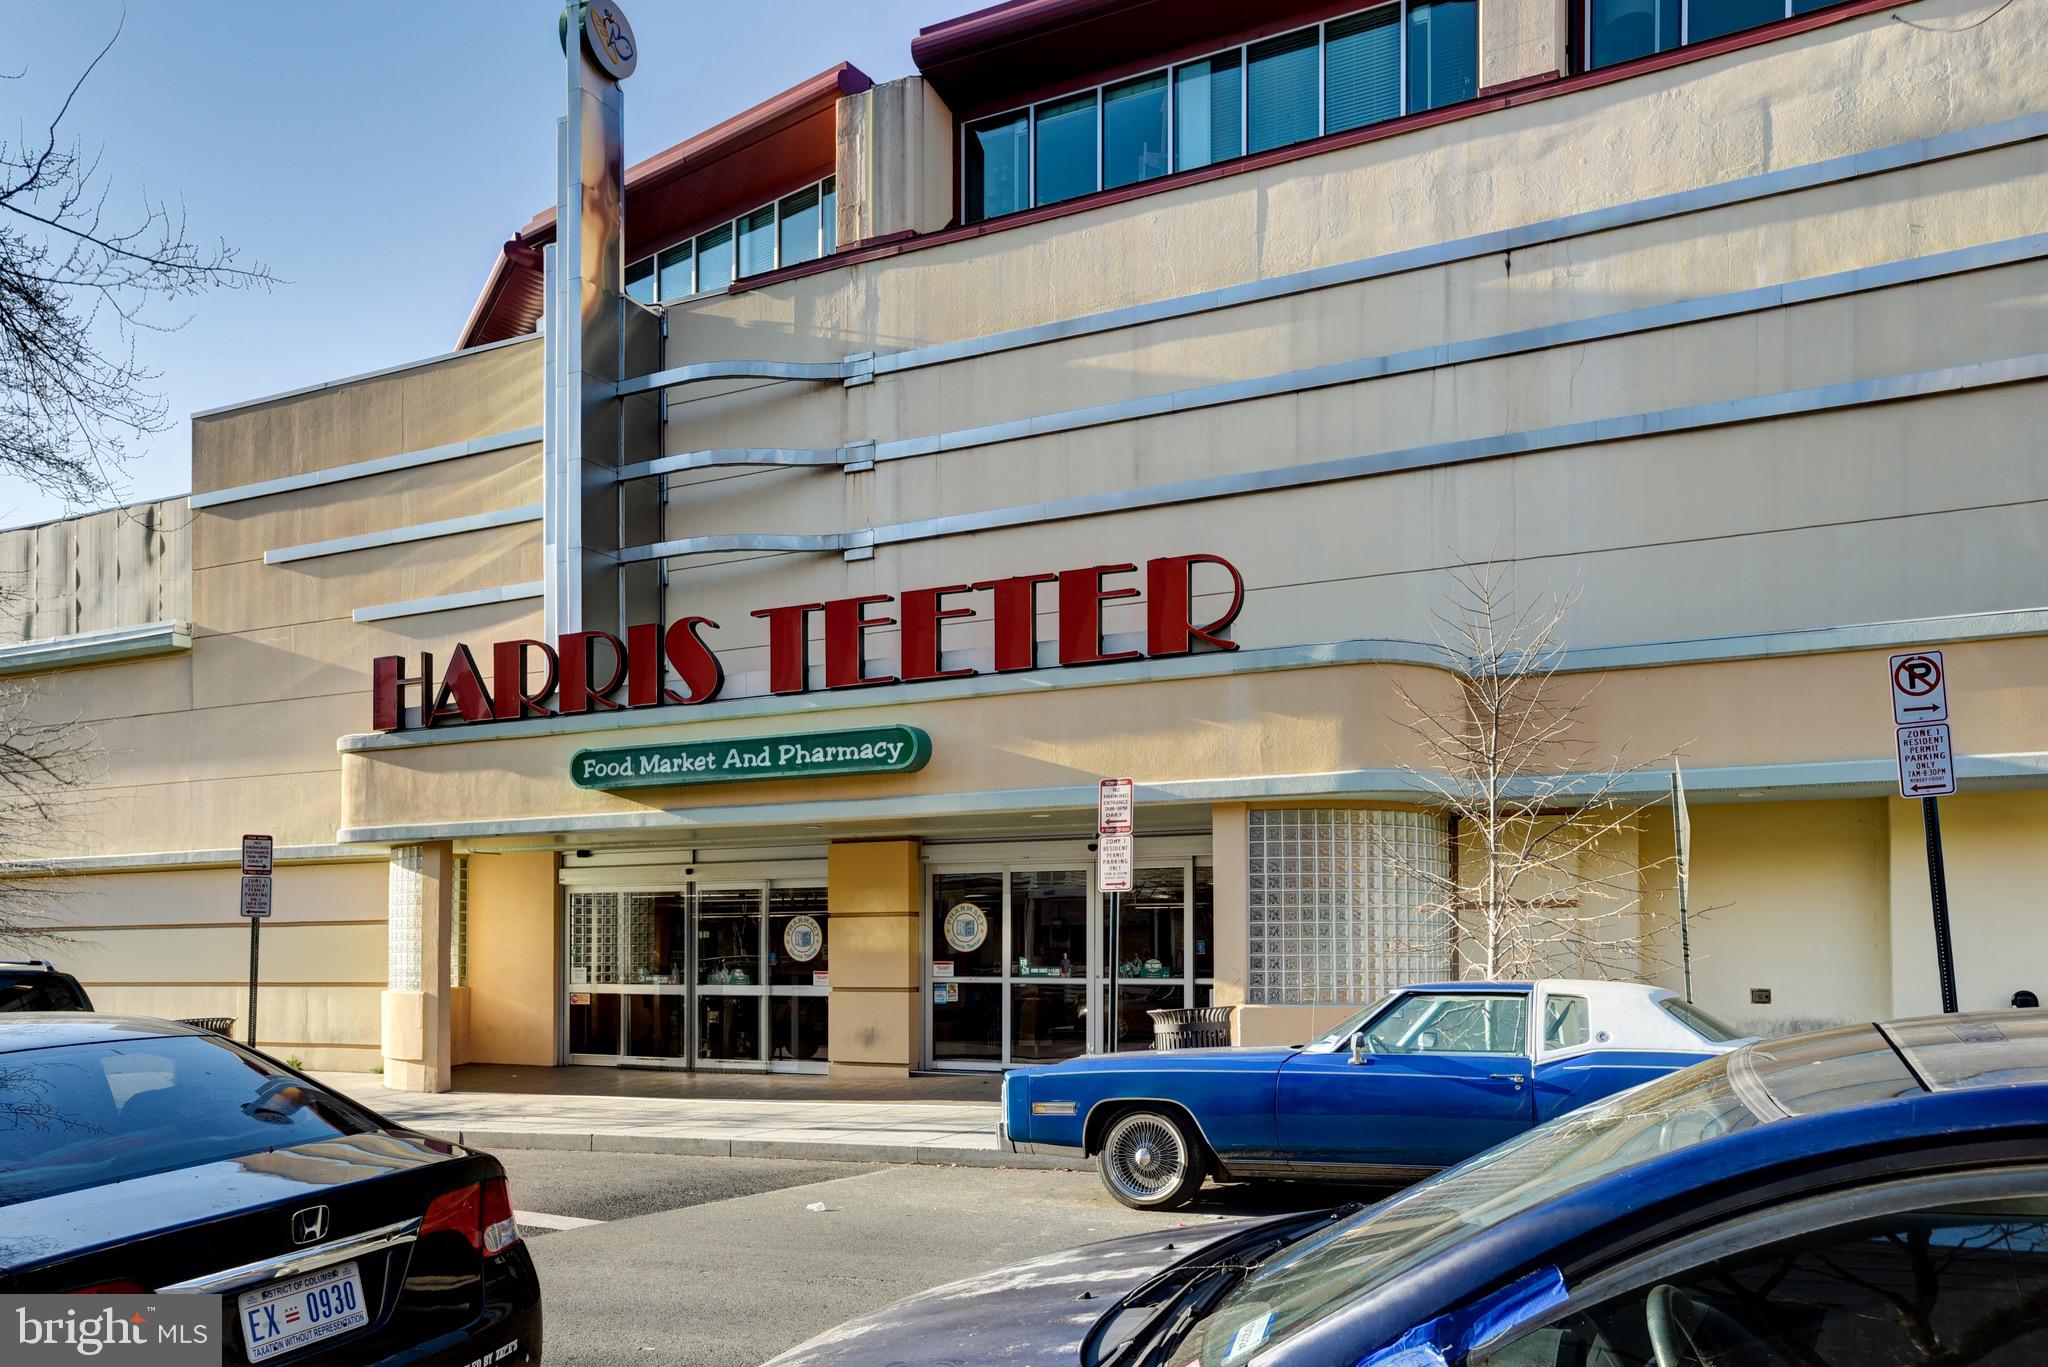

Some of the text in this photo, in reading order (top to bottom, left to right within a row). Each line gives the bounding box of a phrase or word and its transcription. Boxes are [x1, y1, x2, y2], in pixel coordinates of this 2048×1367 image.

[373, 553, 1245, 732] HARRIS TEETER
[1903, 736, 1944, 746] RESIDENT
[1907, 729, 1932, 738] ZONE
[583, 741, 904, 778] Food Market And Pharmacy
[1904, 752, 1946, 762] PARKING
[1909, 745, 1939, 754] PERMIT
[1916, 761, 1935, 769] ONLY
[946, 905, 985, 926] PHARMACY
[786, 917, 820, 937] PHARMACY
[261, 1284, 292, 1300] STRICT
[293, 1280, 303, 1290] OF
[304, 1270, 339, 1287] COLUMB
[247, 1281, 357, 1343] EX 0930
[284, 1330, 313, 1347] WITHOUT
[314, 1313, 365, 1337] REPRESENTATION
[483, 1352, 494, 1367] BY
